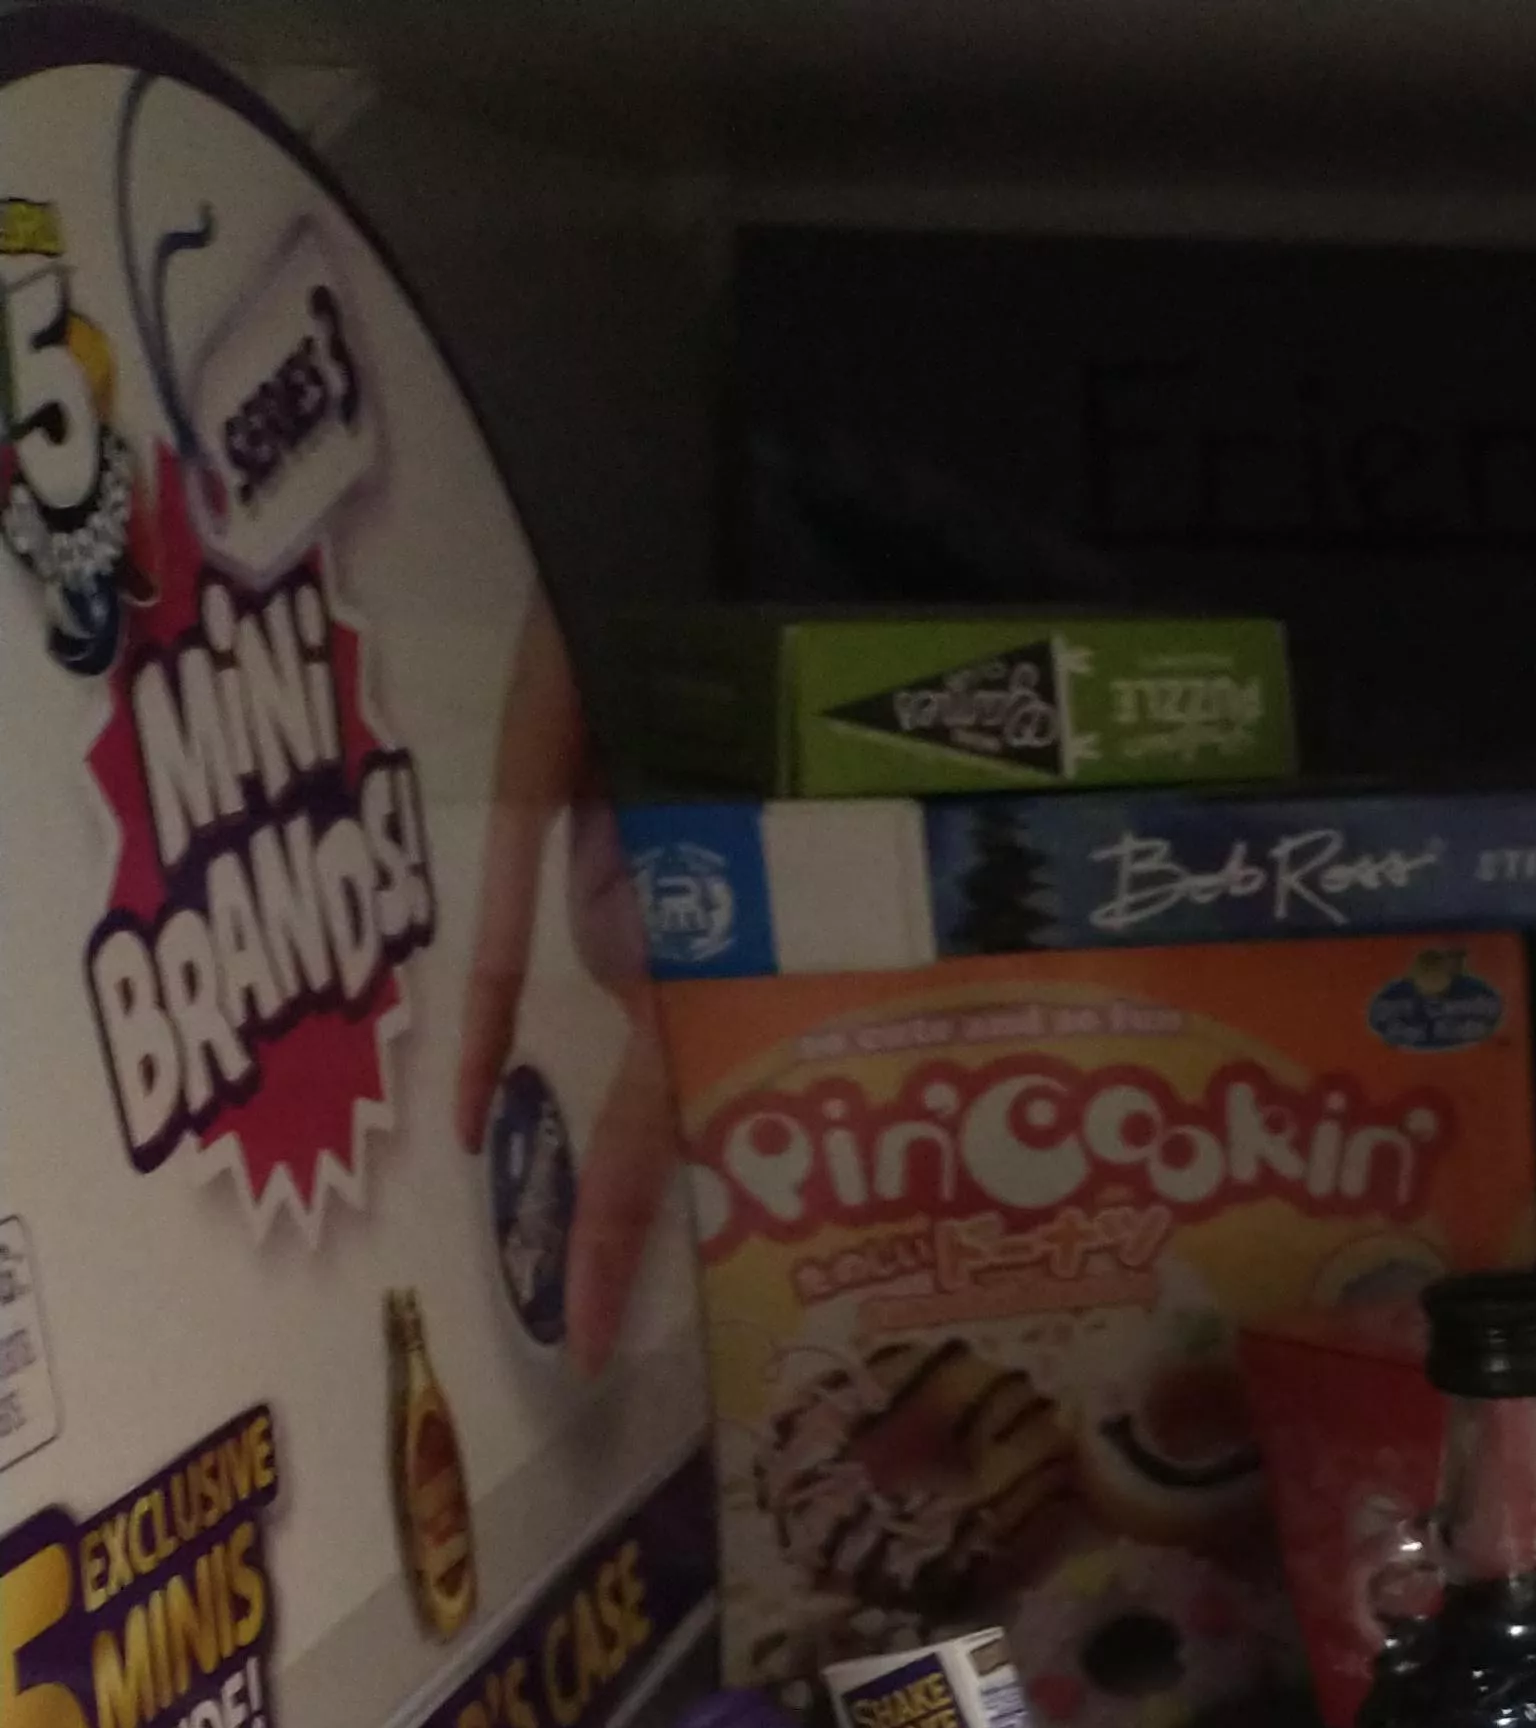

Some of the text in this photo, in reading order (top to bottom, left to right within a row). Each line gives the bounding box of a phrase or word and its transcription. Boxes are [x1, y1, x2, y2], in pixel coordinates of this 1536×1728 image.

[92, 755, 434, 1160] BRANDS!
[1088, 829, 1420, 932] Bob Ross
[80, 1411, 278, 1610] EXCLUSIVE
